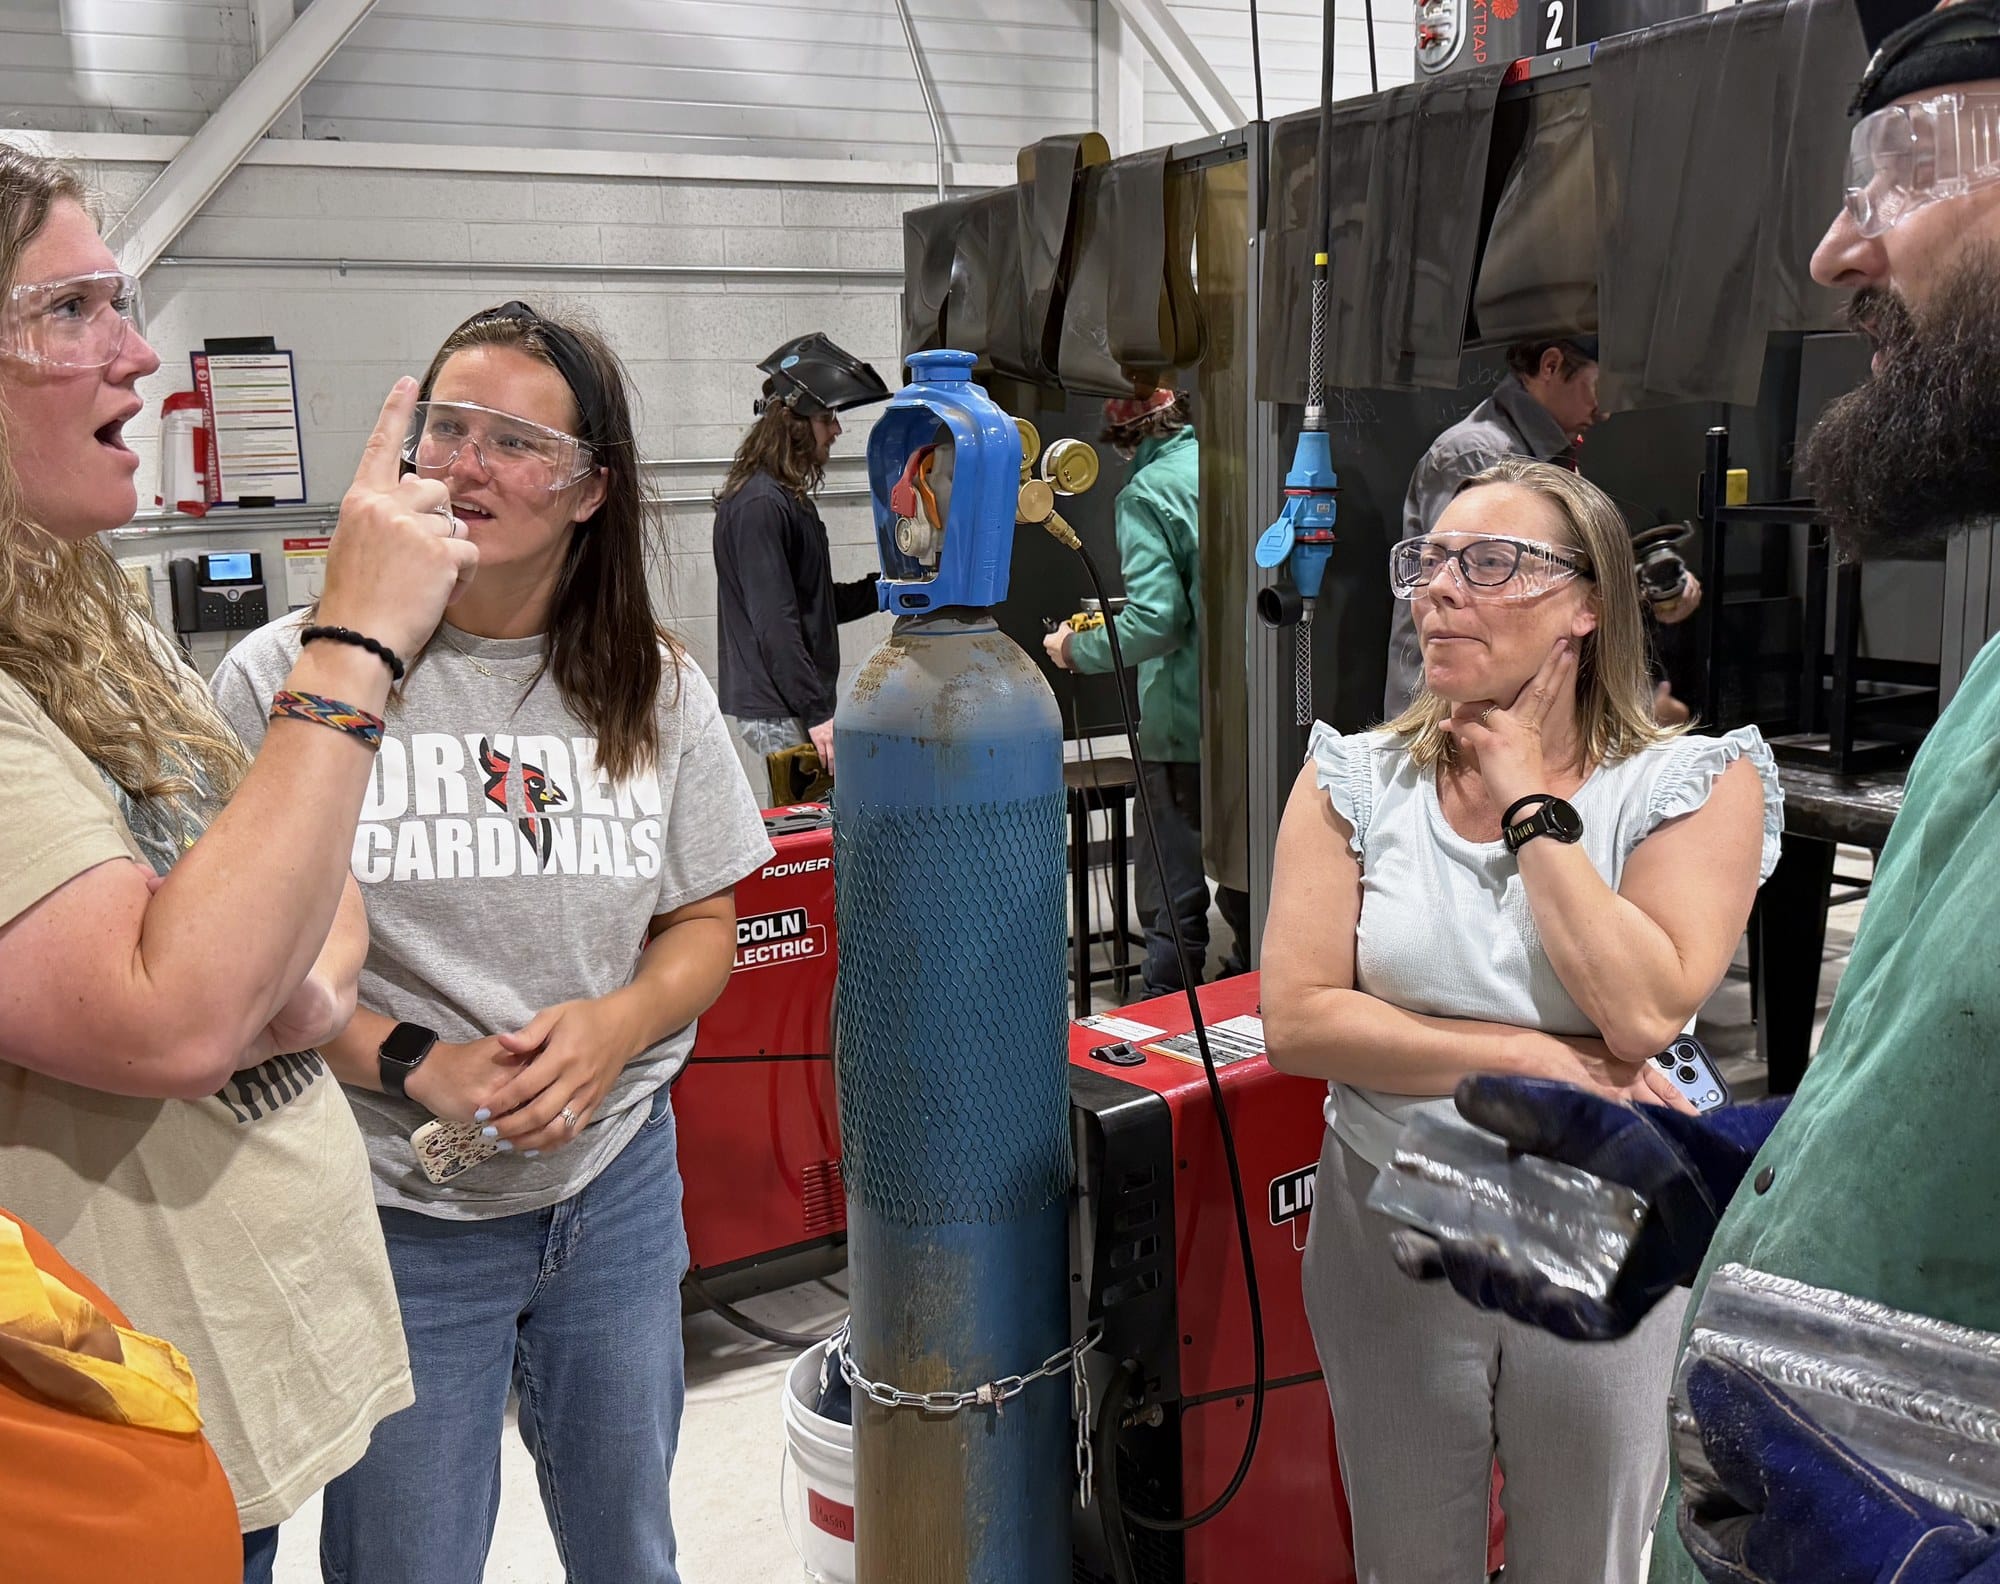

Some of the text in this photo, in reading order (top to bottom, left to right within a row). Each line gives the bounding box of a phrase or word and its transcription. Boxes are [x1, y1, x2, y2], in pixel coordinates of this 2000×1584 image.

[1545, 0, 1564, 50] 2
[359, 733, 662, 821] DRYDEN
[351, 817, 662, 884] CARDINALS
[762, 857, 830, 880] POWER
